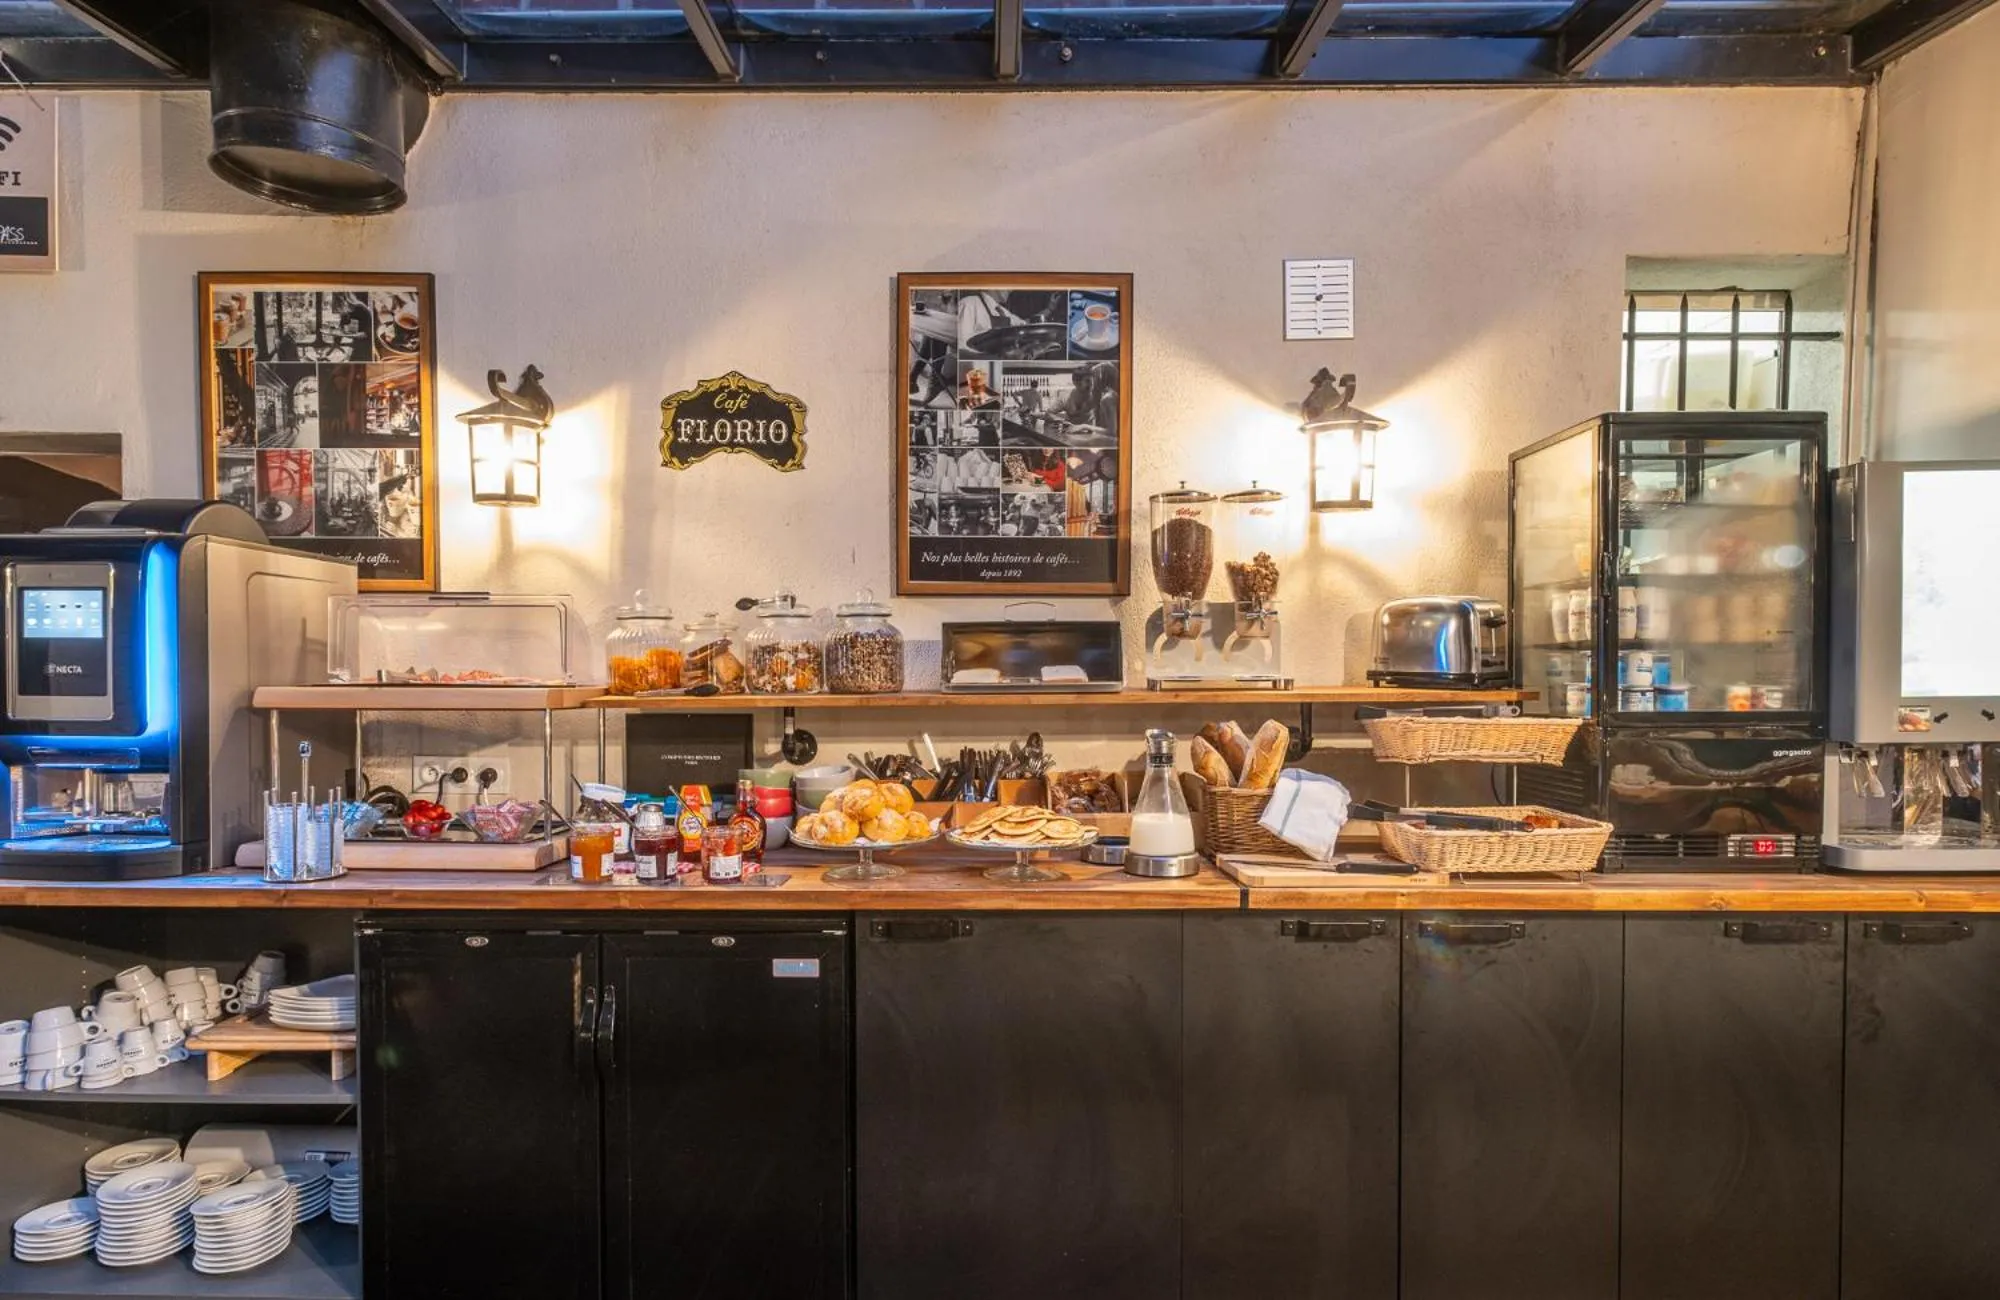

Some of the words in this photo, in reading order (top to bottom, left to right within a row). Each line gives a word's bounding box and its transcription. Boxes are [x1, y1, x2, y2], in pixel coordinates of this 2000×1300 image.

[713, 392, 750, 414] Café
[676, 418, 788, 445] FLORIO
[354, 552, 365, 563] de
[921, 551, 940, 563] Nos
[941, 551, 962, 566] plus
[964, 551, 989, 563] belles
[991, 551, 1031, 563] histoires
[1033, 552, 1045, 563] de
[979, 569, 1002, 579] depuis
[1003, 569, 1022, 577] 1892
[56, 665, 83, 674] NECTA
